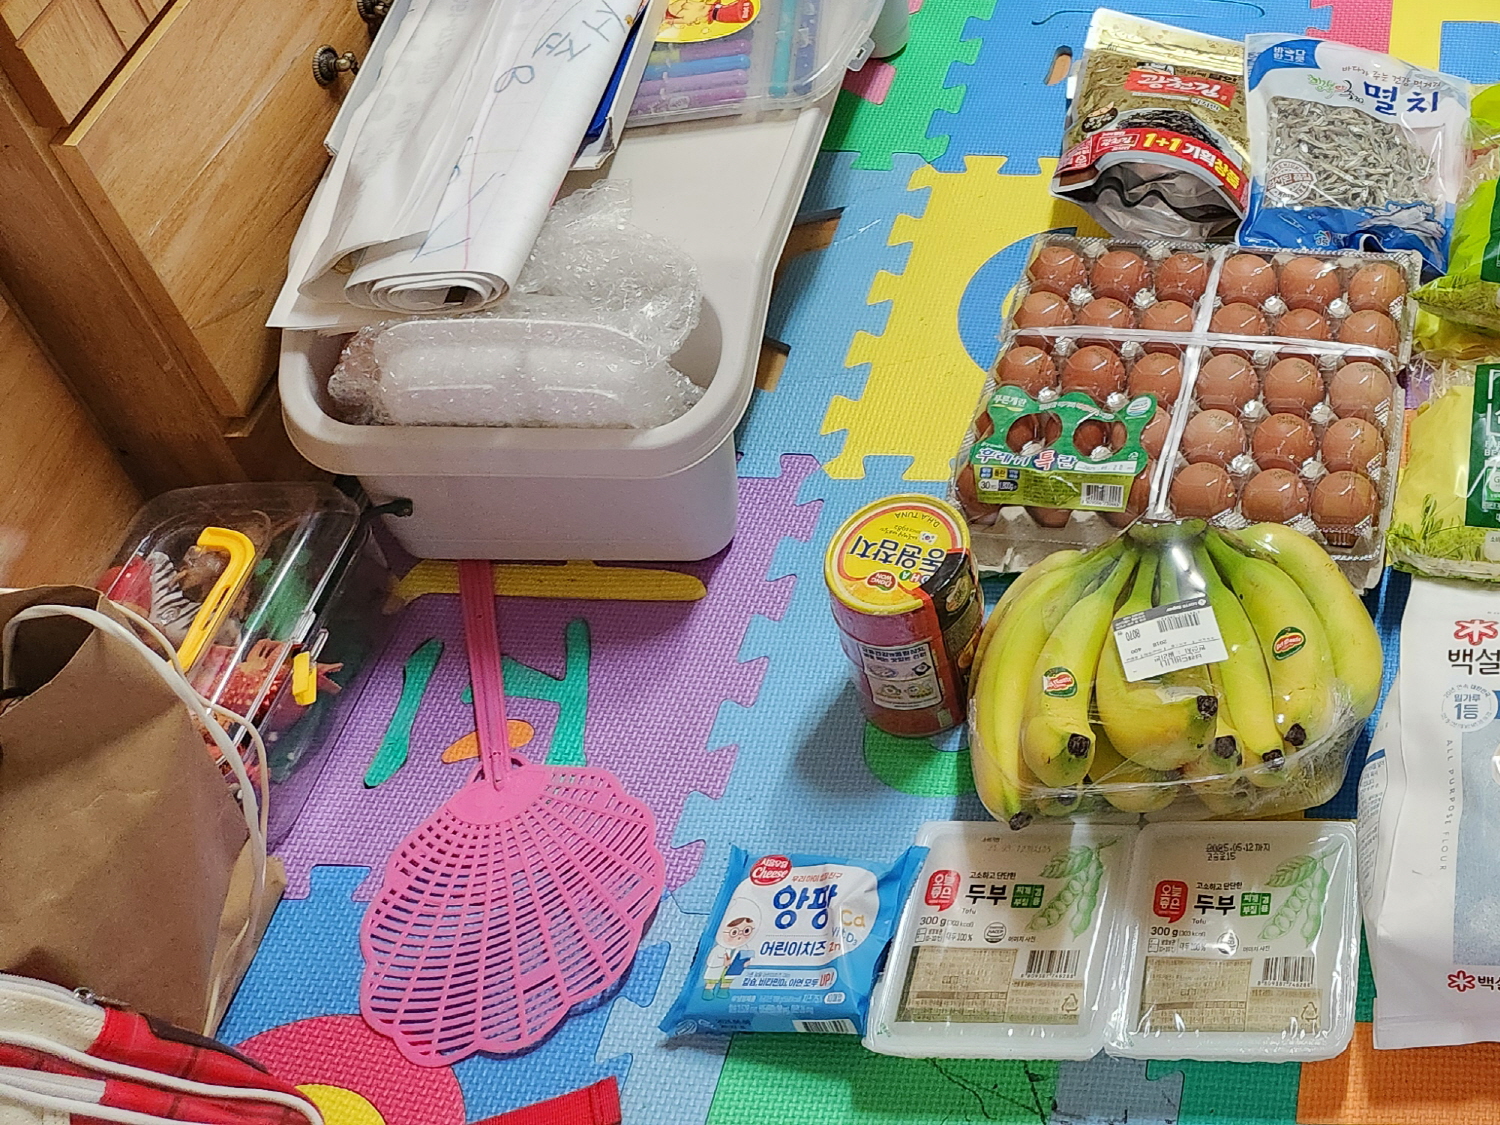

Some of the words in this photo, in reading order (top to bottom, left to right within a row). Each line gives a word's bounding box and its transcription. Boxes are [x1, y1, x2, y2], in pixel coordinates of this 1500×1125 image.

[1138, 74, 1221, 98] 광천김
[1363, 81, 1440, 116] 멸치
[1143, 133, 1183, 152] 1+1
[1182, 142, 1241, 190] 기획상품
[894, 511, 919, 522] TUNA
[848, 535, 946, 579] 동원참치
[870, 577, 894, 589] DONG
[873, 572, 891, 582] WON
[1448, 648, 1500, 676] 백설
[1454, 693, 1481, 703] 밀가루
[1455, 703, 1479, 720] 1등
[1445, 739, 1454, 761] ALL
[1444, 768, 1458, 825] PURPOSE
[1438, 830, 1450, 872] FLOUR
[752, 866, 789, 880] Cheese
[933, 873, 956, 886] 오늘
[969, 871, 995, 880] 고소하고
[996, 871, 1017, 880] 단단한
[930, 886, 953, 900] 좋은
[1161, 884, 1183, 897] 오늘
[1196, 882, 1222, 890] 고소하고
[1223, 882, 1242, 890] 단단한
[965, 884, 1007, 906] 두부
[1159, 897, 1181, 910] 좋은
[772, 884, 838, 930] 앙팡
[962, 907, 977, 915] Tofu
[1194, 894, 1236, 915] 두부
[839, 909, 866, 927] Ca
[919, 916, 939, 927] 300
[940, 917, 947, 928] g
[1151, 927, 1170, 937] 300
[1171, 929, 1178, 938] g
[759, 940, 827, 958] 어린이치즈
[789, 977, 803, 988] 아연
[803, 977, 819, 988] 모두
[819, 971, 835, 988] UP!
